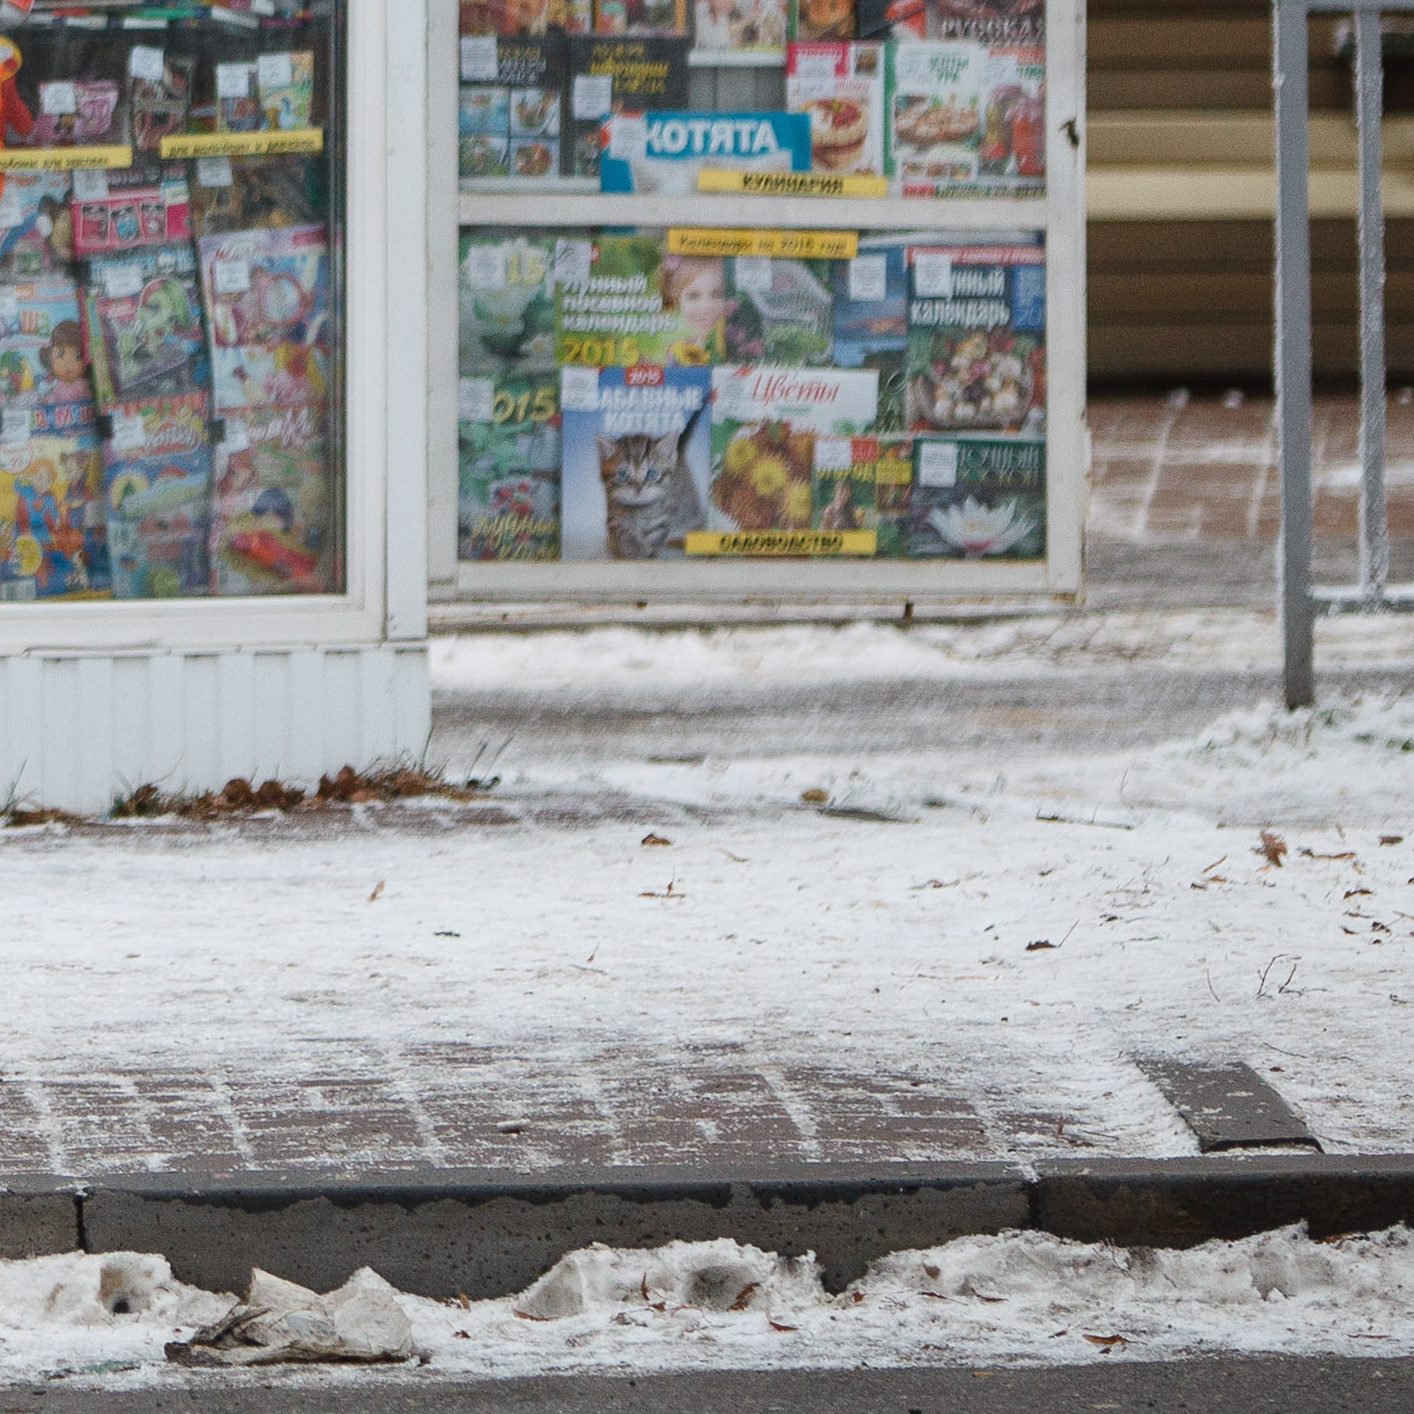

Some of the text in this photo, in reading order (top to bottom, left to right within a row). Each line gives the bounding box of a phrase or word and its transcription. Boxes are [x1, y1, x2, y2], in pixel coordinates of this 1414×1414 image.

[645, 119, 779, 155] КОТЯТА
[504, 253, 546, 285] 15
[909, 299, 1011, 328] календарь
[562, 337, 641, 366] 2015
[492, 388, 560, 425] 015
